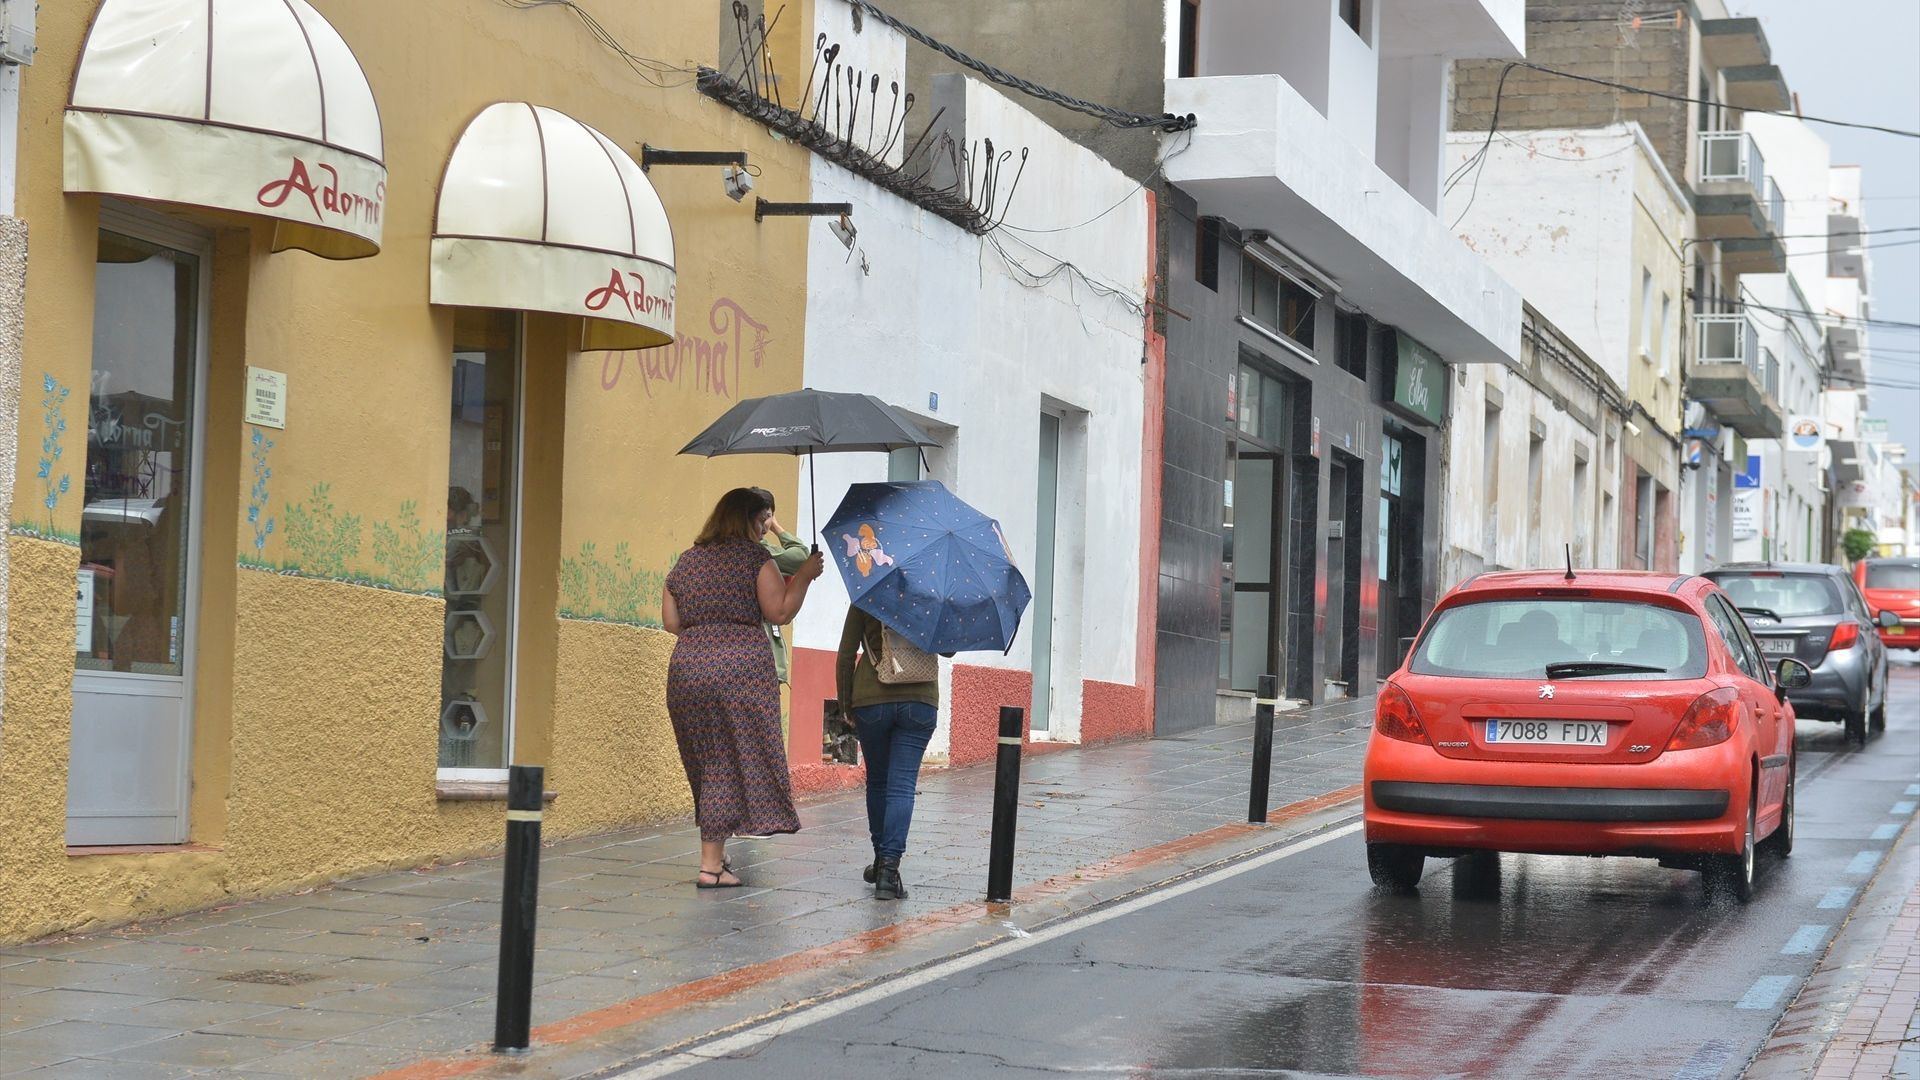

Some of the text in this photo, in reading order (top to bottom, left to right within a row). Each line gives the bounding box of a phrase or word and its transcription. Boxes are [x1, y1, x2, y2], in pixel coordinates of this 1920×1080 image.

[1770, 639, 1791, 651] JHY
[1499, 721, 1549, 741] 7088
[1562, 723, 1602, 743] FDX
[1628, 744, 1652, 753] 207
